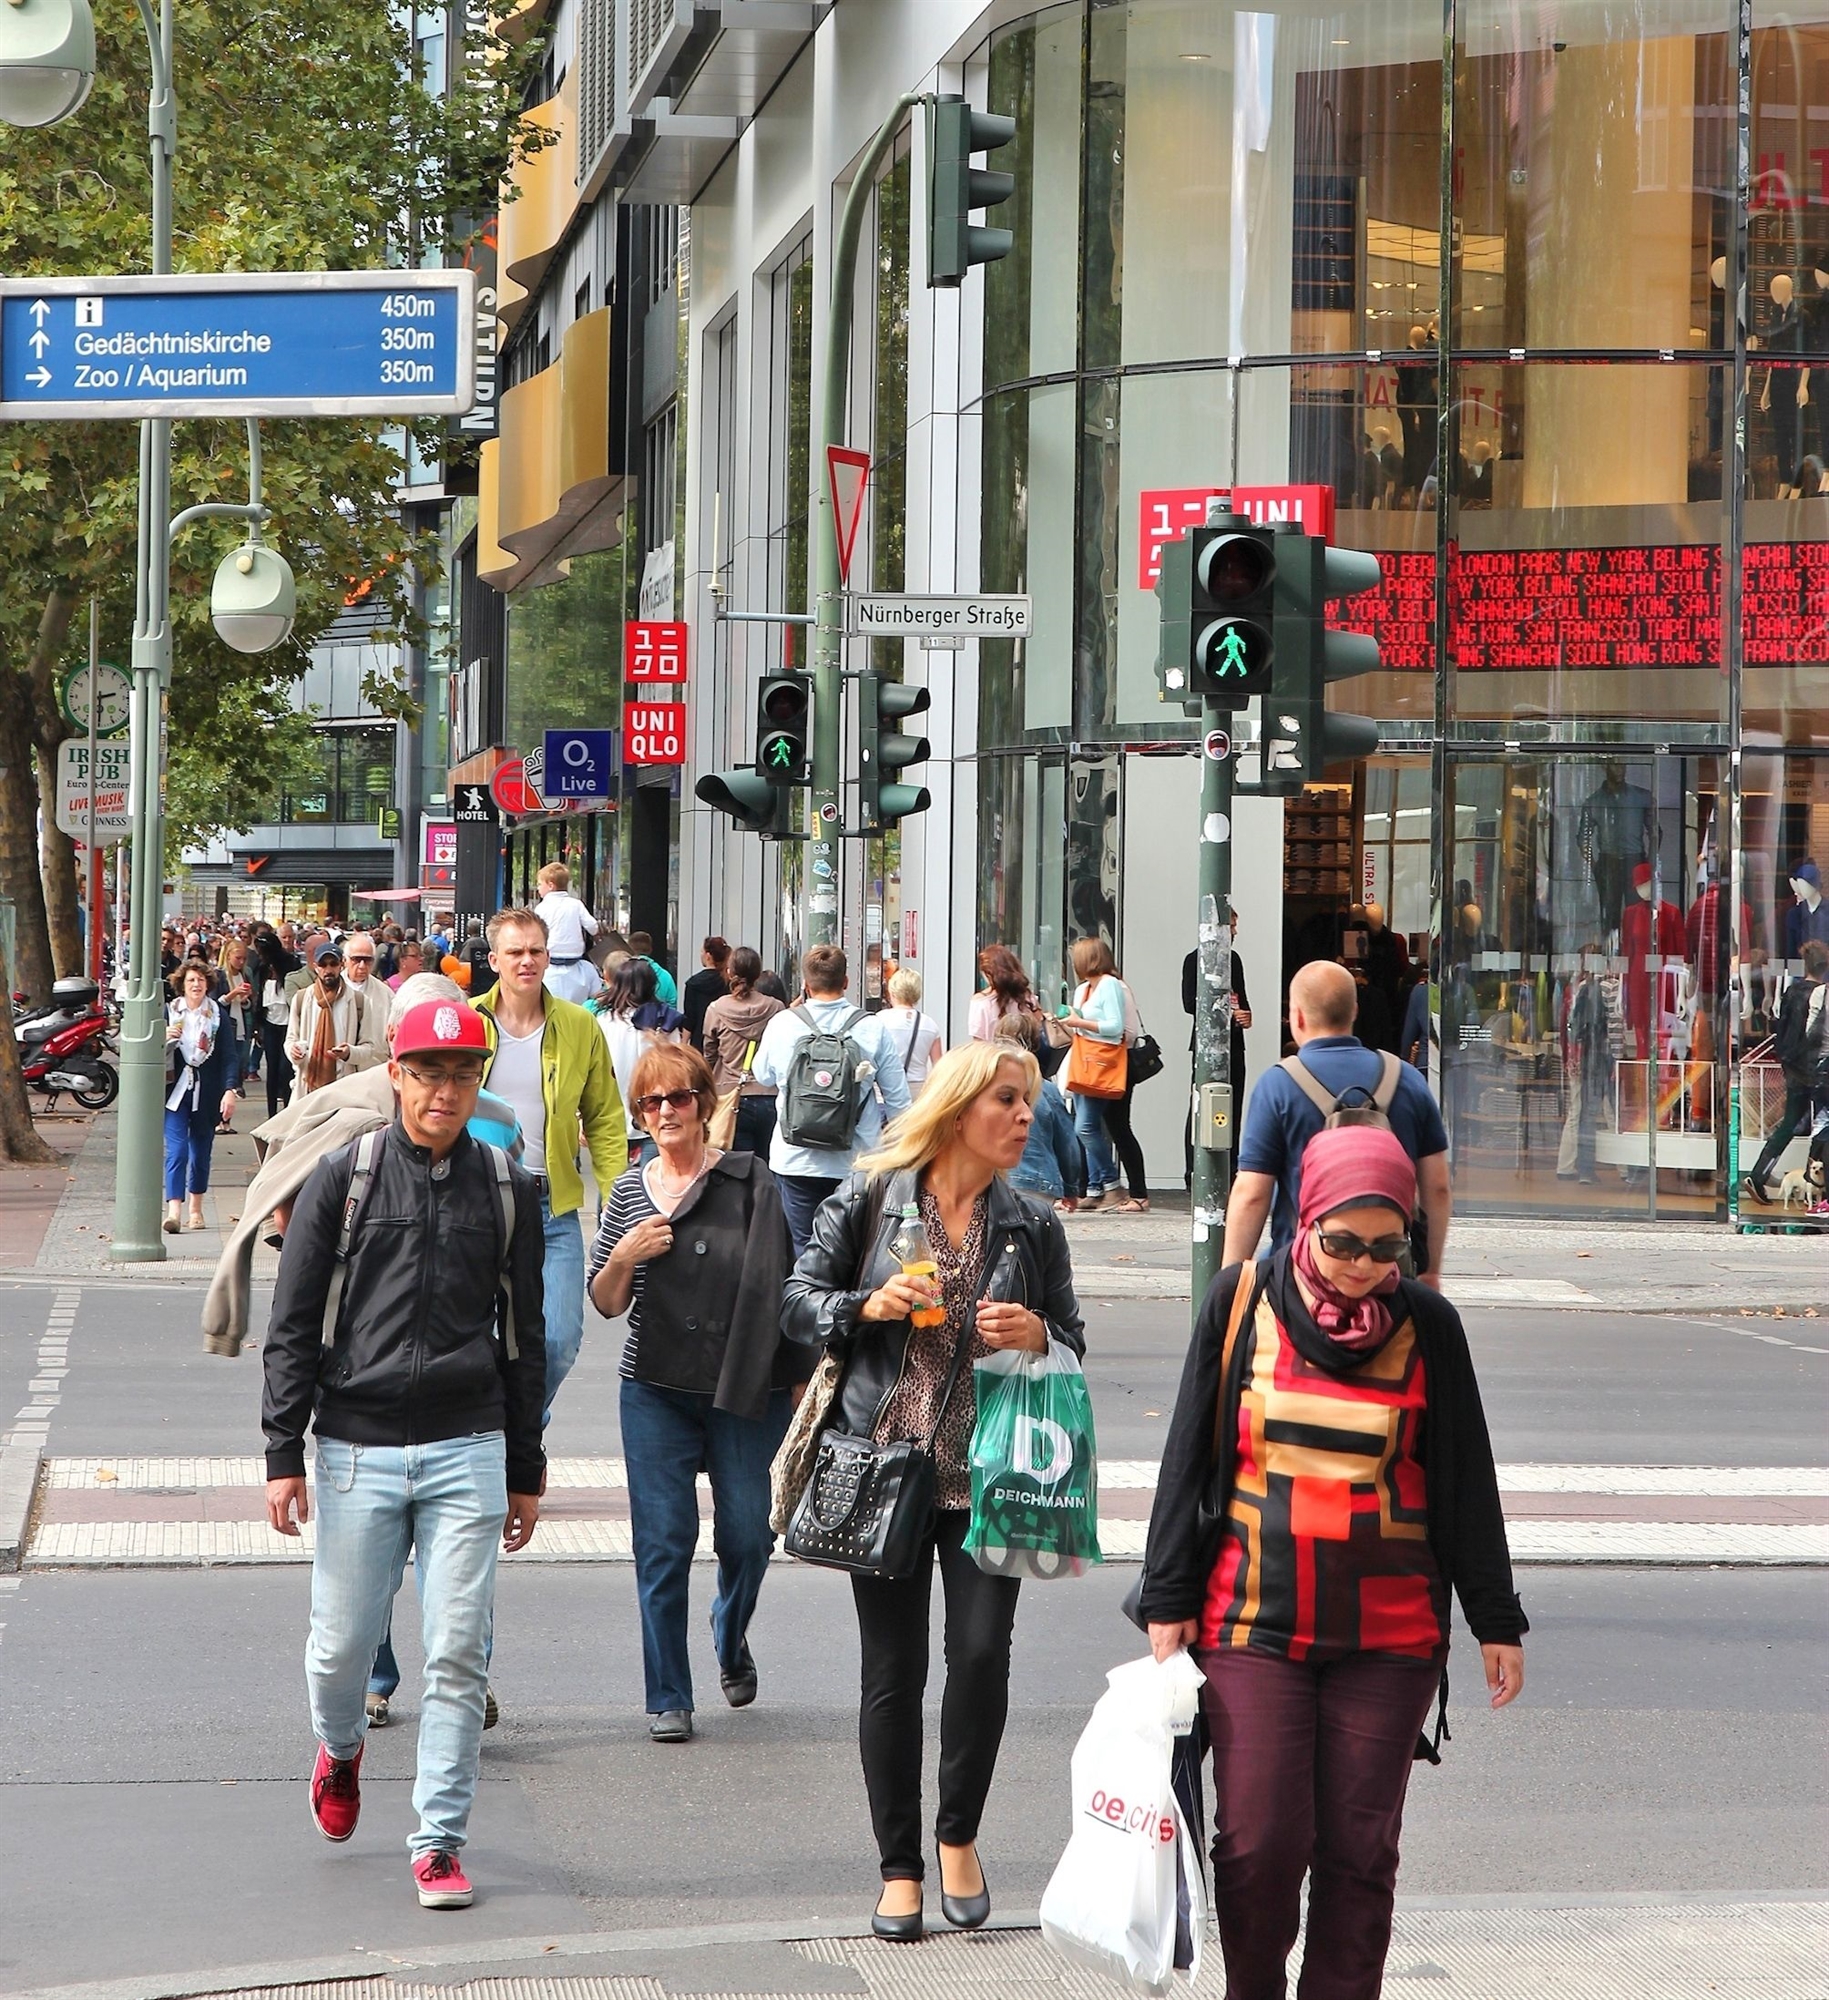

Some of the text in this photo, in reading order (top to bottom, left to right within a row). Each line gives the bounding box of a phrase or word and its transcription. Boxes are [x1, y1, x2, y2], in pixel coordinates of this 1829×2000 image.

[380, 296, 435, 319] 450m
[75, 328, 435, 356] Gedächtniskirche 350m
[74, 365, 119, 388] Zoo
[138, 363, 247, 391] Aquarium
[380, 361, 434, 383] 350m
[1457, 553, 1515, 577] LONDON
[1519, 551, 1562, 575] PARIS
[1566, 550, 1601, 573] NEW
[1606, 550, 1649, 572] YORK
[1385, 577, 1434, 600] PARIS
[1479, 577, 1521, 599] YORK
[1582, 572, 1657, 596] SHANGHAI
[1661, 571, 1708, 594] SEOUL
[1759, 568, 1803, 592] KONG
[860, 604, 1025, 629] Nürnberger Straße
[1346, 599, 1394, 621] YORK
[1462, 598, 1534, 621] SHANGHAI
[1588, 596, 1629, 619] HONG
[1633, 595, 1675, 618] KONG
[1679, 594, 1711, 616] SAN
[1380, 622, 1430, 645] SEOUL
[1480, 621, 1521, 644] KONG
[1525, 620, 1555, 643] SAN
[1558, 619, 1641, 644] FRANCISCO
[1645, 617, 1691, 641] TAIPEI
[1489, 644, 1562, 667] SHANGHAI
[1566, 642, 1611, 666] SEOUL
[1615, 642, 1657, 665] HONG
[1661, 641, 1703, 665] KONG
[631, 711, 674, 731] UNI
[631, 735, 679, 760] QLO
[77, 764, 119, 780] PUB
[561, 776, 597, 792] Live
[69, 791, 125, 812] LIVE MUSIK
[81, 814, 127, 827] GINNESS
[457, 810, 490, 821] HOTEL
[1364, 852, 1375, 887] ULTRA
[1012, 1413, 1074, 1485] D
[993, 1486, 1086, 1509] DEICHMANN
